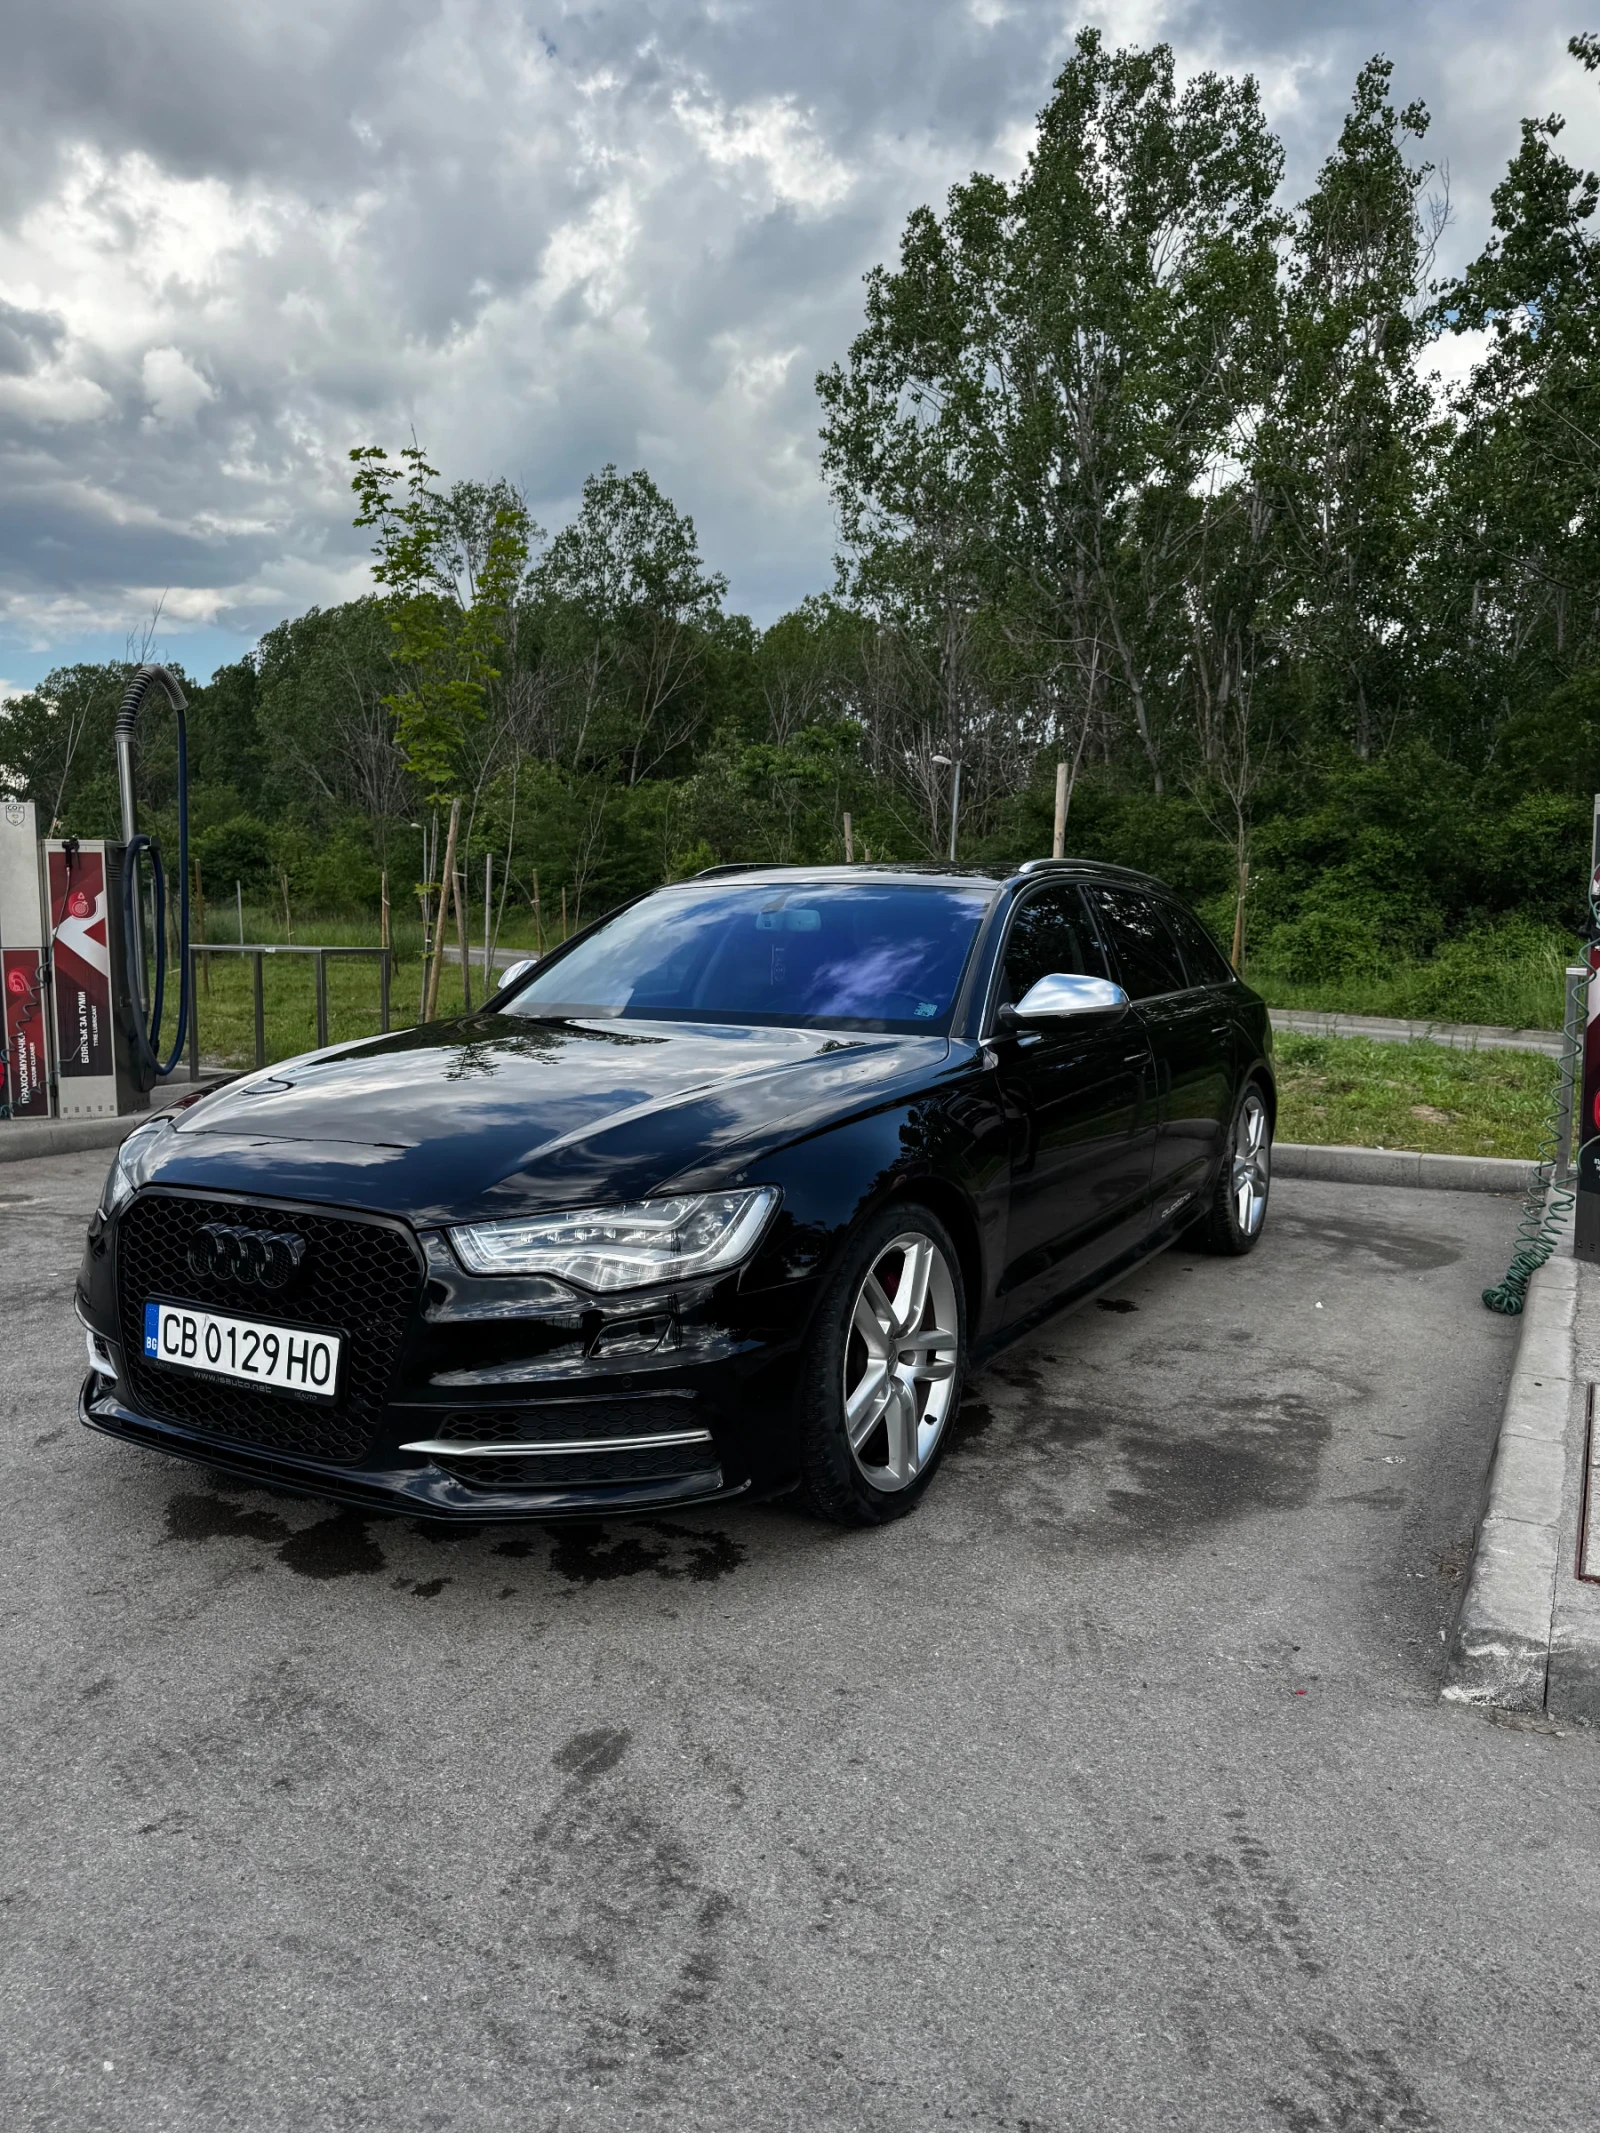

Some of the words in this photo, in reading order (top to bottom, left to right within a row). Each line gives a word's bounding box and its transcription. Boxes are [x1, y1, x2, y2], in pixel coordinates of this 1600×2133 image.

[78, 991, 87, 1014] ГУМИ
[79, 1016, 88, 1027] ЗА
[80, 1028, 89, 1064] БЛЯСЪК
[146, 1336, 157, 1350] BG
[163, 1313, 198, 1359] CB
[205, 1322, 280, 1376] 0129
[193, 1370, 272, 1394] www.isauto.net
